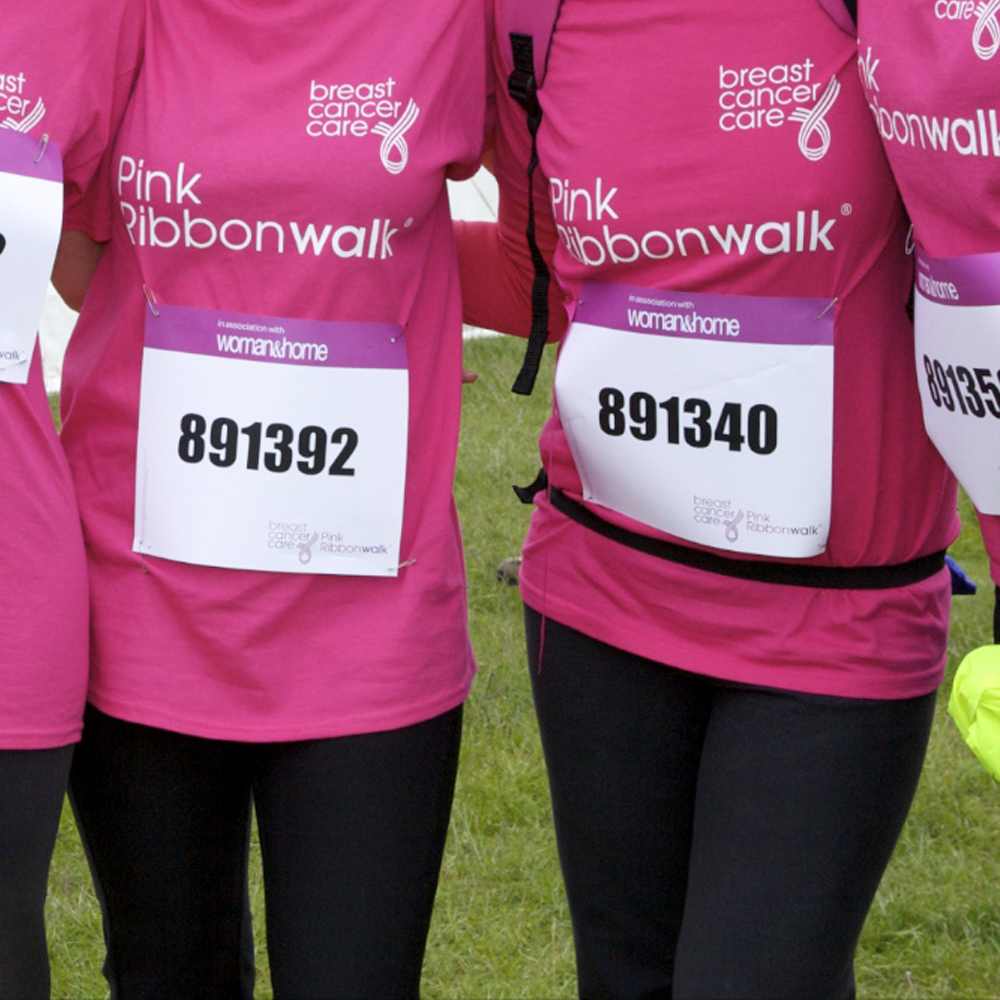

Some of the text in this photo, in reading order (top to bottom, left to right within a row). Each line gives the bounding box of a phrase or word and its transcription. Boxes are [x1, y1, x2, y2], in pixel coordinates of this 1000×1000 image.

[934, 0, 975, 20] care
[719, 58, 814, 89] breast
[310, 77, 396, 101] breast
[719, 83, 821, 110] cancer
[308, 100, 401, 119] cancer
[719, 108, 785, 131] care
[306, 120, 368, 137] care
[118, 155, 201, 204] Pink
[549, 177, 619, 221] Pink
[120, 201, 399, 260] Ribbonwalk
[557, 210, 837, 266] Ribbonwalk
[225, 321, 268, 332] association
[269, 325, 285, 334] with
[628, 308, 740, 336] woman&home
[217, 333, 328, 361] woman&home
[923, 354, 1000, 420] 89135
[598, 387, 778, 456] 891340
[177, 413, 359, 476] 891392
[693, 494, 731, 509] breast
[693, 506, 735, 519] cancer
[693, 515, 720, 526] care
[746, 510, 770, 522] Pink
[268, 520, 308, 532] breast
[268, 531, 310, 541] cancer
[746, 520, 818, 536] Ribbonwalk
[267, 540, 295, 550] care
[321, 532, 343, 542] Pink
[320, 543, 388, 555] Ribbonwalk
